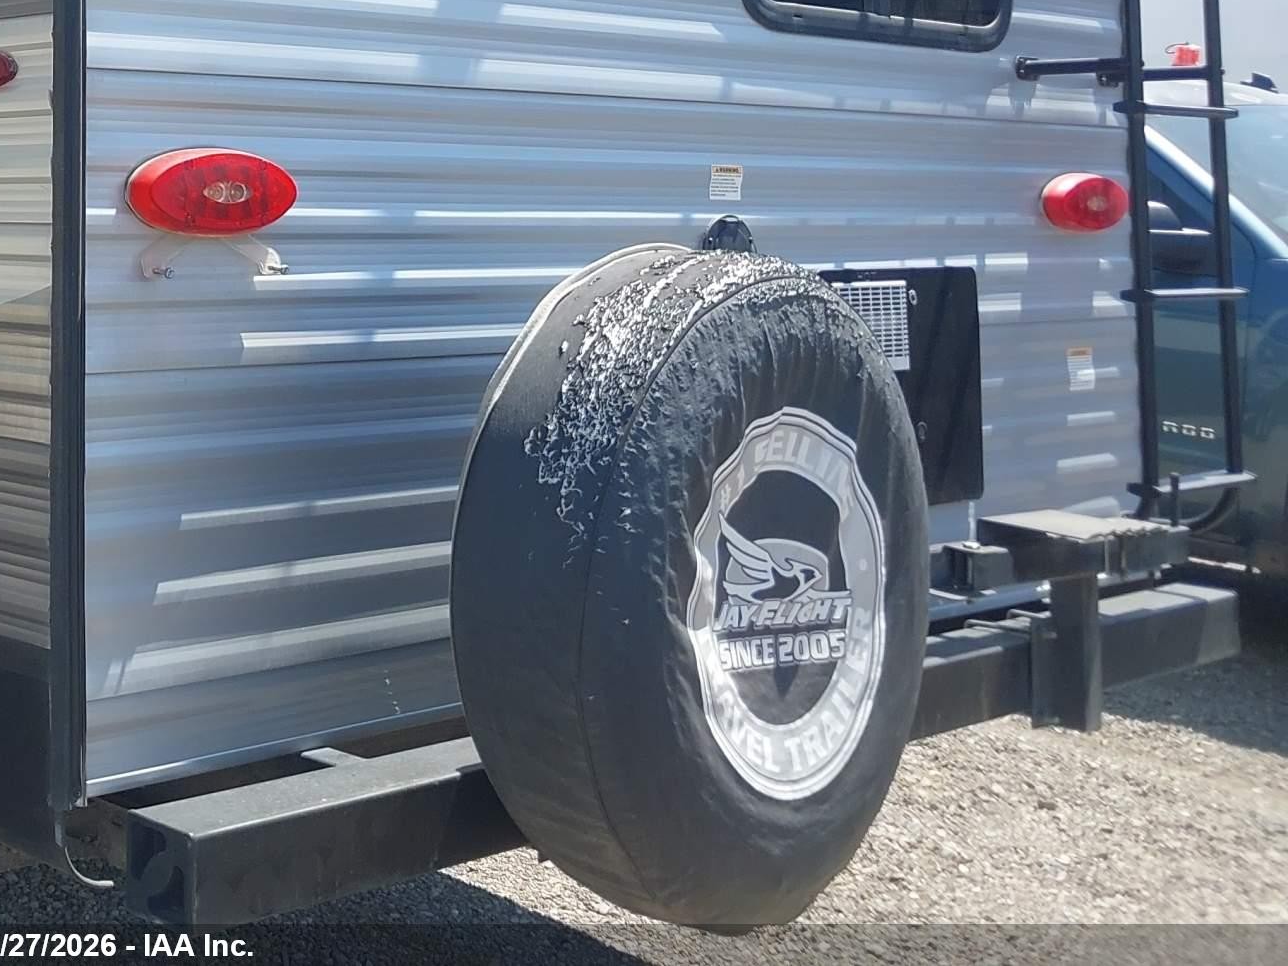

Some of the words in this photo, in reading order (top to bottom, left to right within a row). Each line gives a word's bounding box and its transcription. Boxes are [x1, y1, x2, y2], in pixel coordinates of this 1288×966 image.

[719, 636, 775, 671] SINCE
[777, 631, 846, 666] 2005
[784, 607, 872, 771] TRAILER
